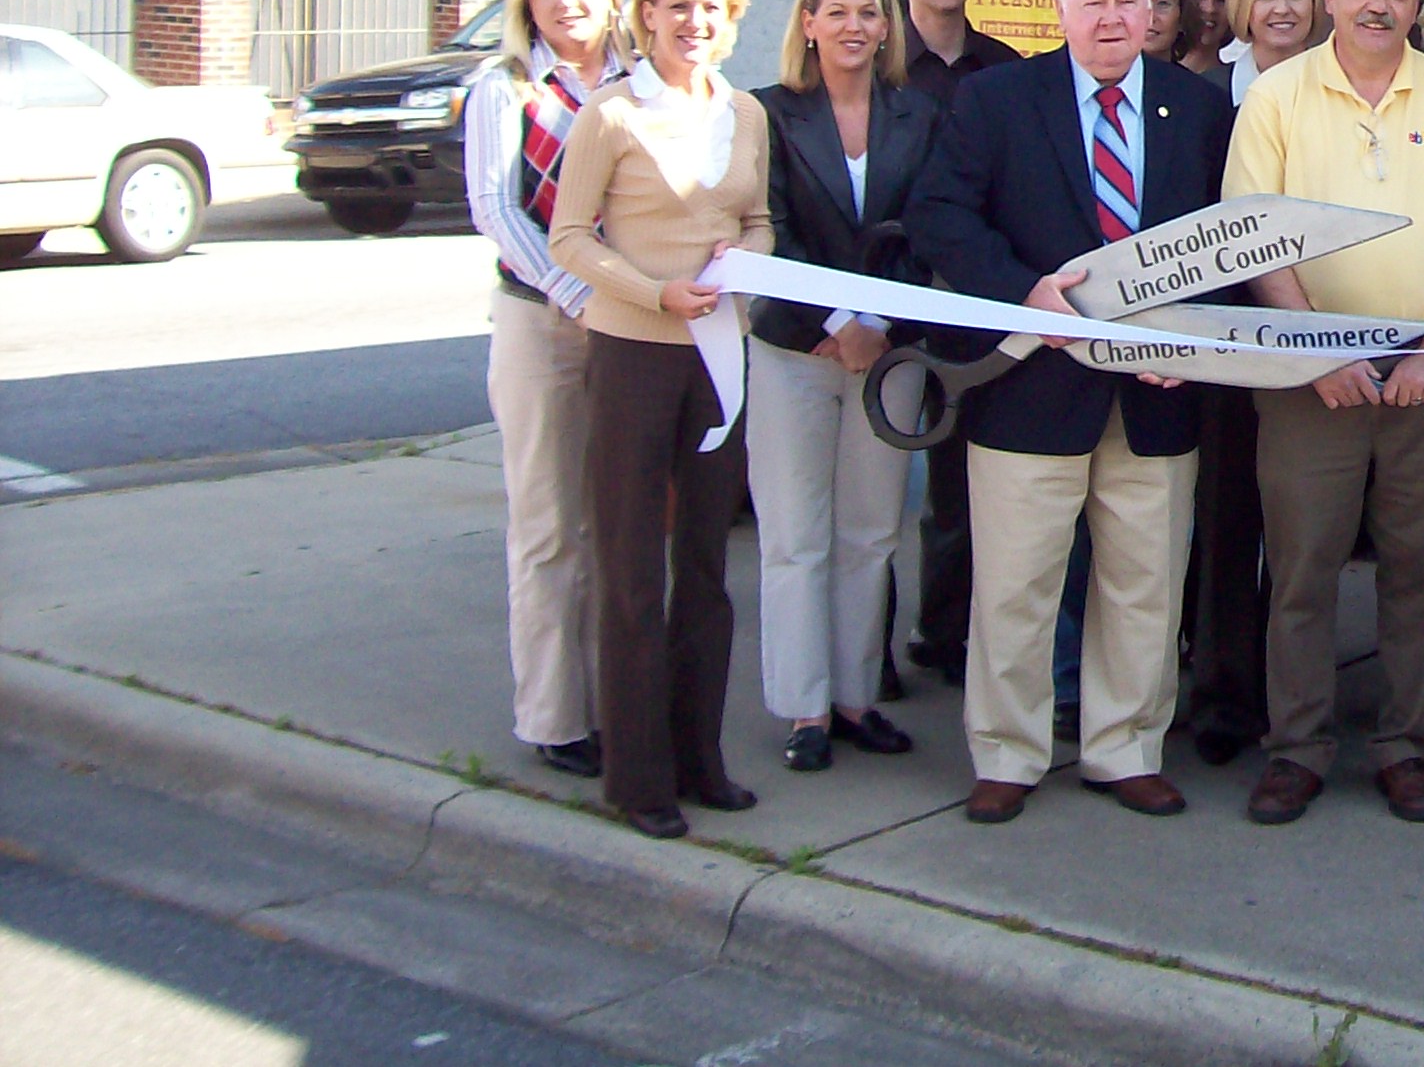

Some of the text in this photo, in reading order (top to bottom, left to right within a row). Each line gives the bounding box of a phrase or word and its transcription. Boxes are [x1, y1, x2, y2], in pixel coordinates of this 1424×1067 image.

[1134, 211, 1269, 269] Lincolnton-
[1116, 233, 1306, 307] Lincoln County
[1088, 338, 1199, 365] Chamber
[1255, 323, 1400, 349] Commerce
